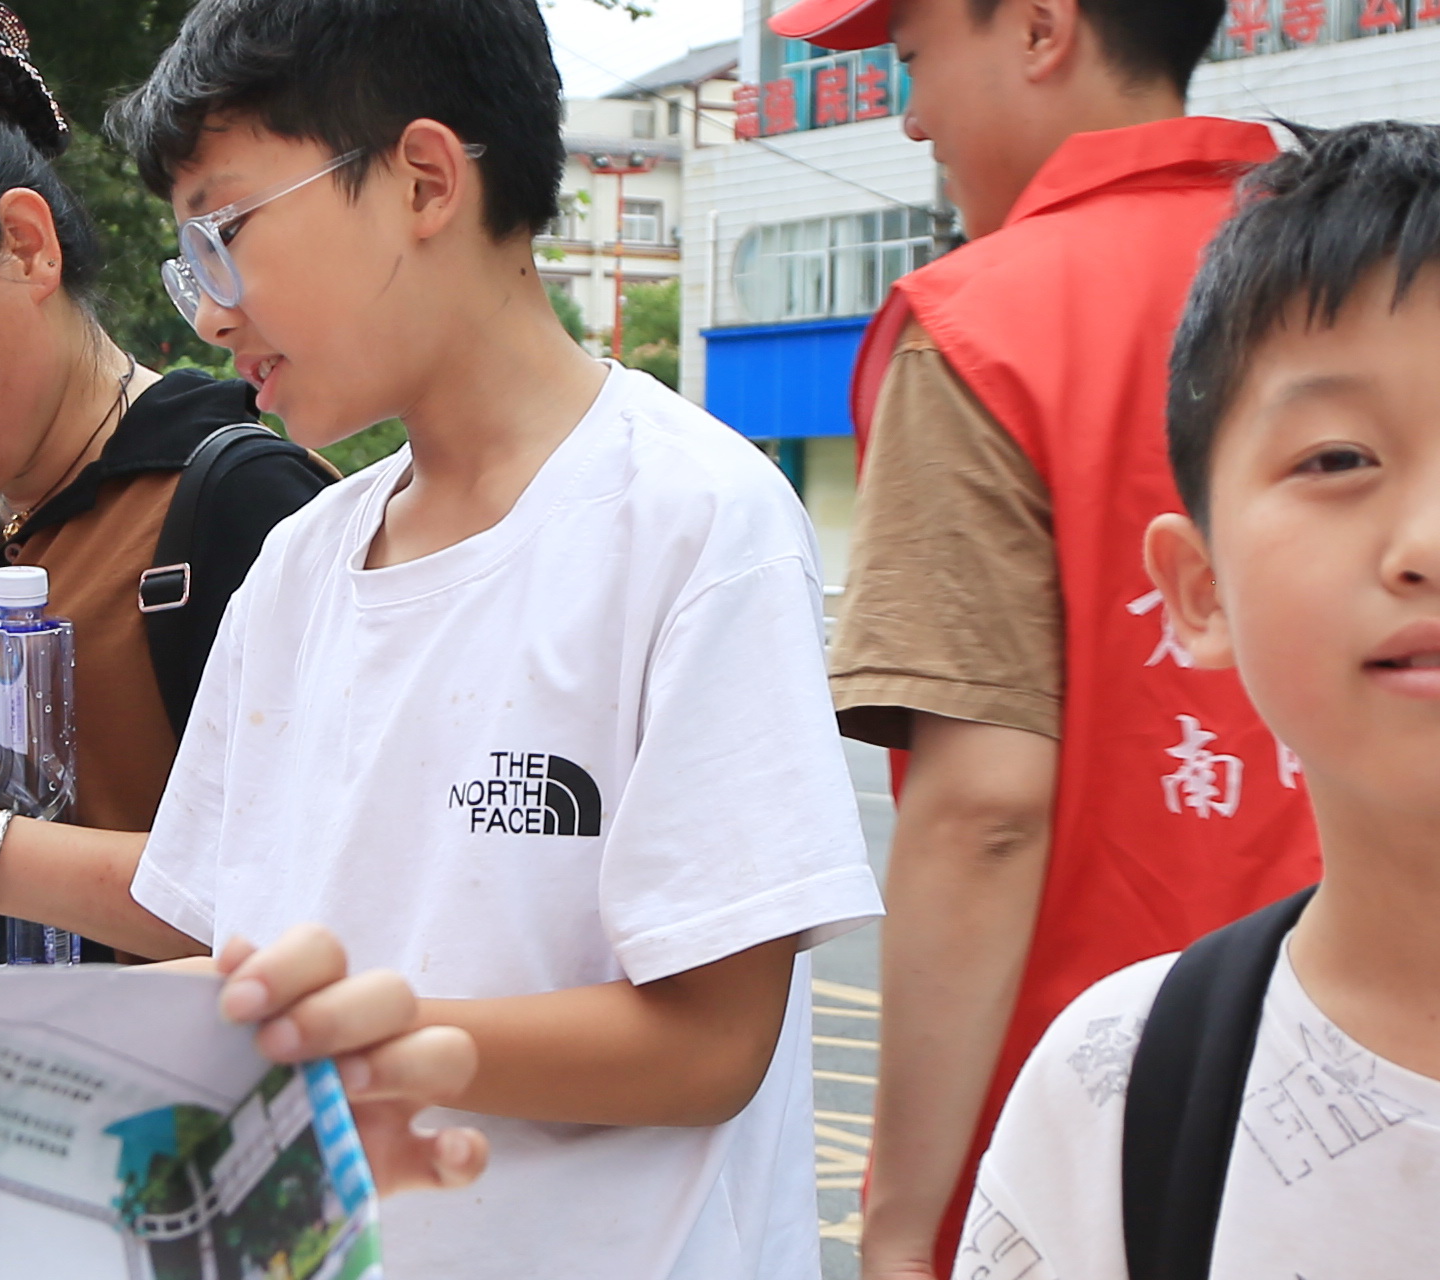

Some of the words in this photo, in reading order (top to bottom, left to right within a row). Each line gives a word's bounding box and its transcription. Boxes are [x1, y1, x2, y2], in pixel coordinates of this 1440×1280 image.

[489, 751, 545, 779] THE
[448, 779, 542, 809] NORTH
[470, 807, 541, 834] FACE
